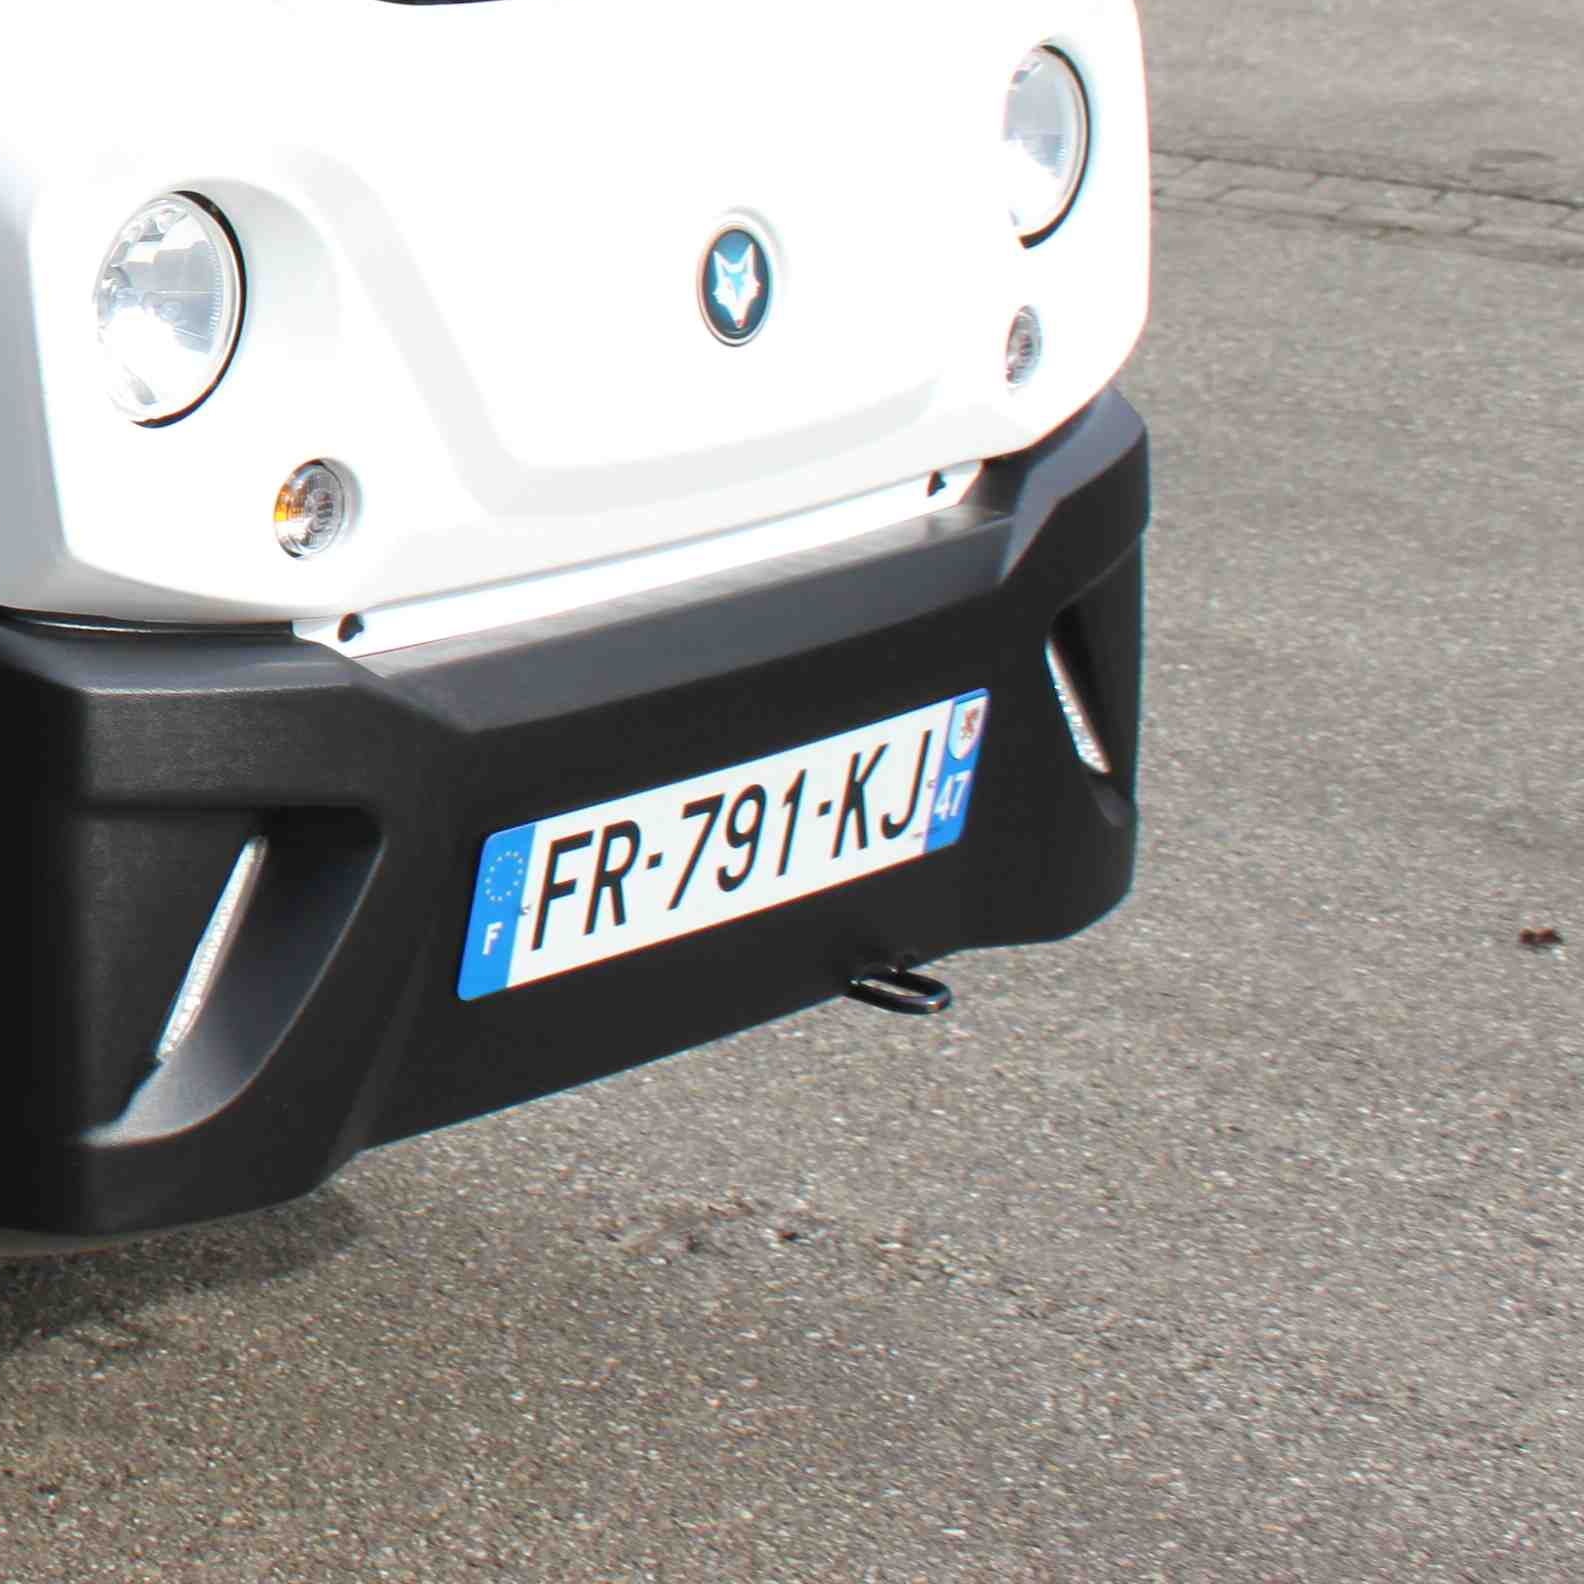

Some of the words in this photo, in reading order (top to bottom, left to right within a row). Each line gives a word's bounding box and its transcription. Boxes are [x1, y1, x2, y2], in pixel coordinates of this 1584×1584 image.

[935, 769, 972, 820] 47
[532, 730, 933, 950] FR-791-KJ
[482, 923, 502, 955] F
